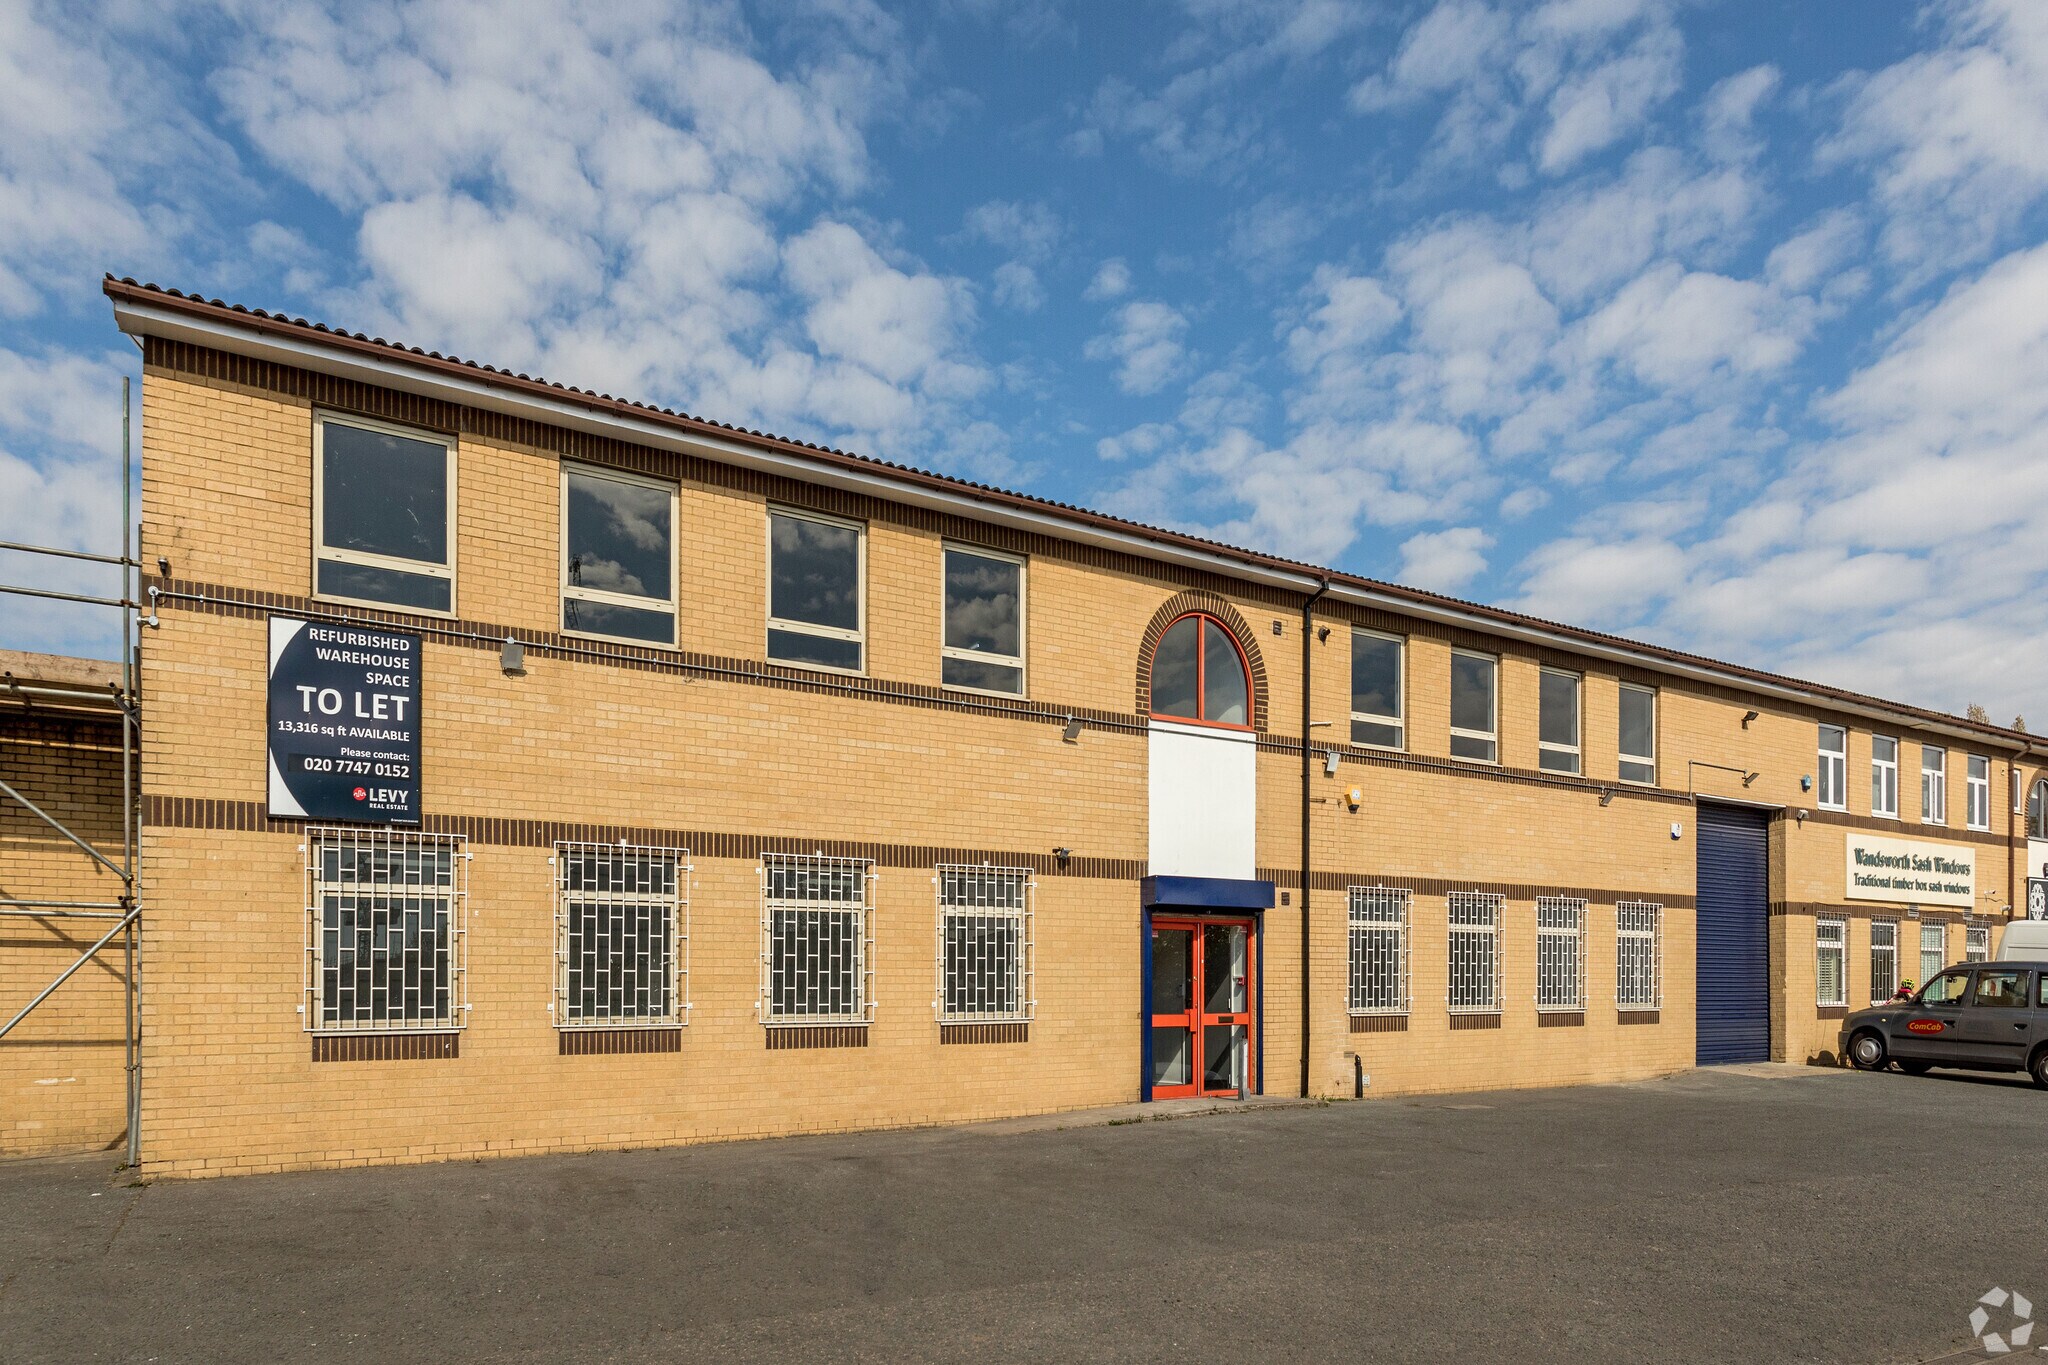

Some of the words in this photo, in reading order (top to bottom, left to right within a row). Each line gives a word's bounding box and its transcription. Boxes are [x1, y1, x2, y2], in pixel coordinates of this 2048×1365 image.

[309, 628, 410, 651] REFURBISHED
[316, 647, 410, 670] WAREHOUSE
[365, 672, 410, 688] SPACE
[296, 685, 343, 715] TO
[355, 691, 410, 721] LET
[278, 720, 319, 734] 13,316
[321, 726, 334, 737] sq
[337, 725, 347, 737] ft
[349, 727, 410, 742] AVAILABLE
[340, 747, 371, 759] Please
[373, 750, 410, 762] contact:
[304, 757, 332, 772] 020
[335, 760, 371, 775] 7747
[374, 763, 410, 778] 0152
[369, 788, 409, 804] LEVY
[386, 803, 409, 811] ESTATE
[1854, 848, 1910, 870] Wandsworth
[1912, 854, 1932, 872] Sash
[1934, 857, 1970, 876] Windows
[1854, 872, 1891, 889] Traditional
[1892, 876, 1915, 891] timber
[1915, 878, 1928, 892] box
[1928, 880, 1942, 893] sash
[1943, 882, 1970, 894] windows
[1909, 1022, 1942, 1031] ComCab
